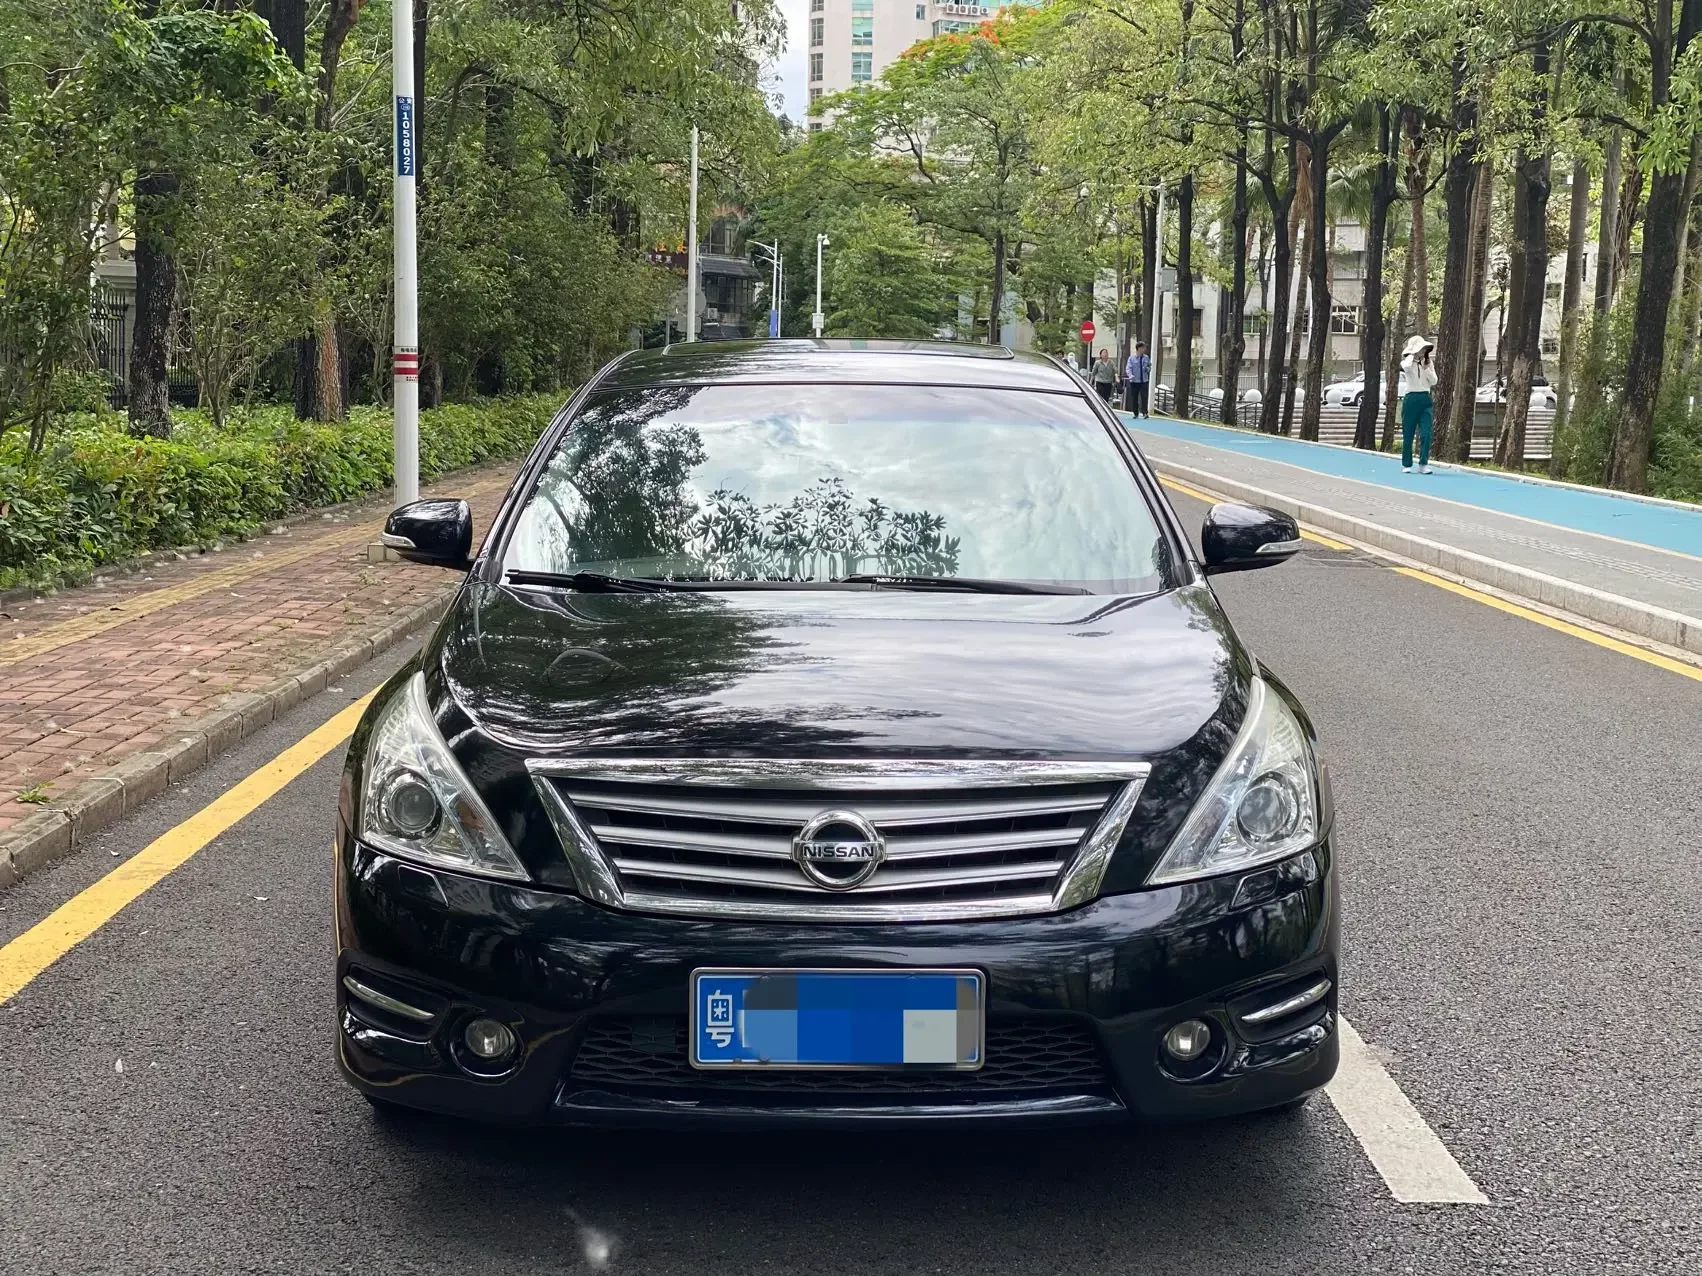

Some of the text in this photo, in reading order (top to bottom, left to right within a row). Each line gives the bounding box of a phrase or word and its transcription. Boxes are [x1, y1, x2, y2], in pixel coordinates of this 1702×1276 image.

[402, 111, 411, 174] 1058027
[803, 846, 874, 857] NISSAN
[705, 989, 735, 1048] 粤
